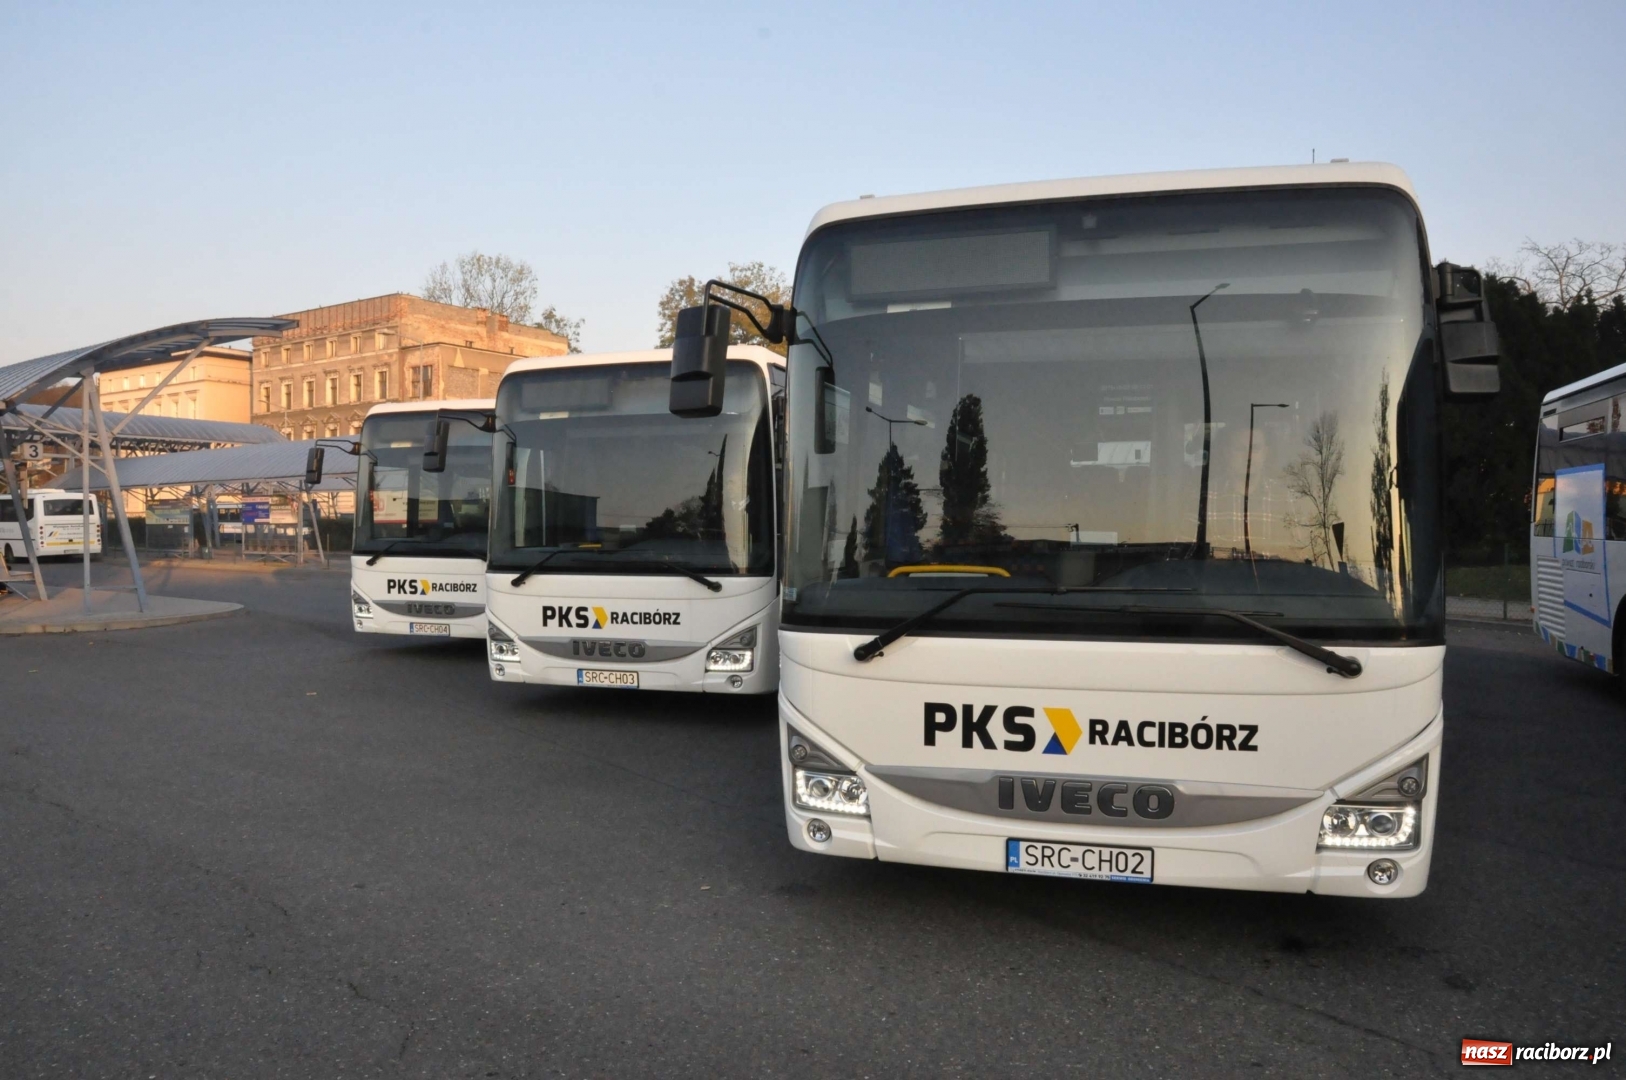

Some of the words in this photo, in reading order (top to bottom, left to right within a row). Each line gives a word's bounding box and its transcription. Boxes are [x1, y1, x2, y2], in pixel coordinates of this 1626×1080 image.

[29, 445, 38, 458] 3
[387, 578, 418, 595] PKS
[431, 581, 477, 592] RACIBÓRZ
[407, 603, 455, 615] IVECO
[542, 605, 589, 628] PKS
[610, 608, 681, 625] RACIBÓRZ
[572, 640, 646, 658] IVECO
[584, 671, 635, 685] SRC-CH03
[923, 702, 1036, 752] PKS
[1088, 715, 1259, 752] RACIBÓRZ
[997, 776, 1175, 819] IVECO
[1009, 856, 1018, 864] PL
[1025, 844, 1144, 875] SRC-CH02
